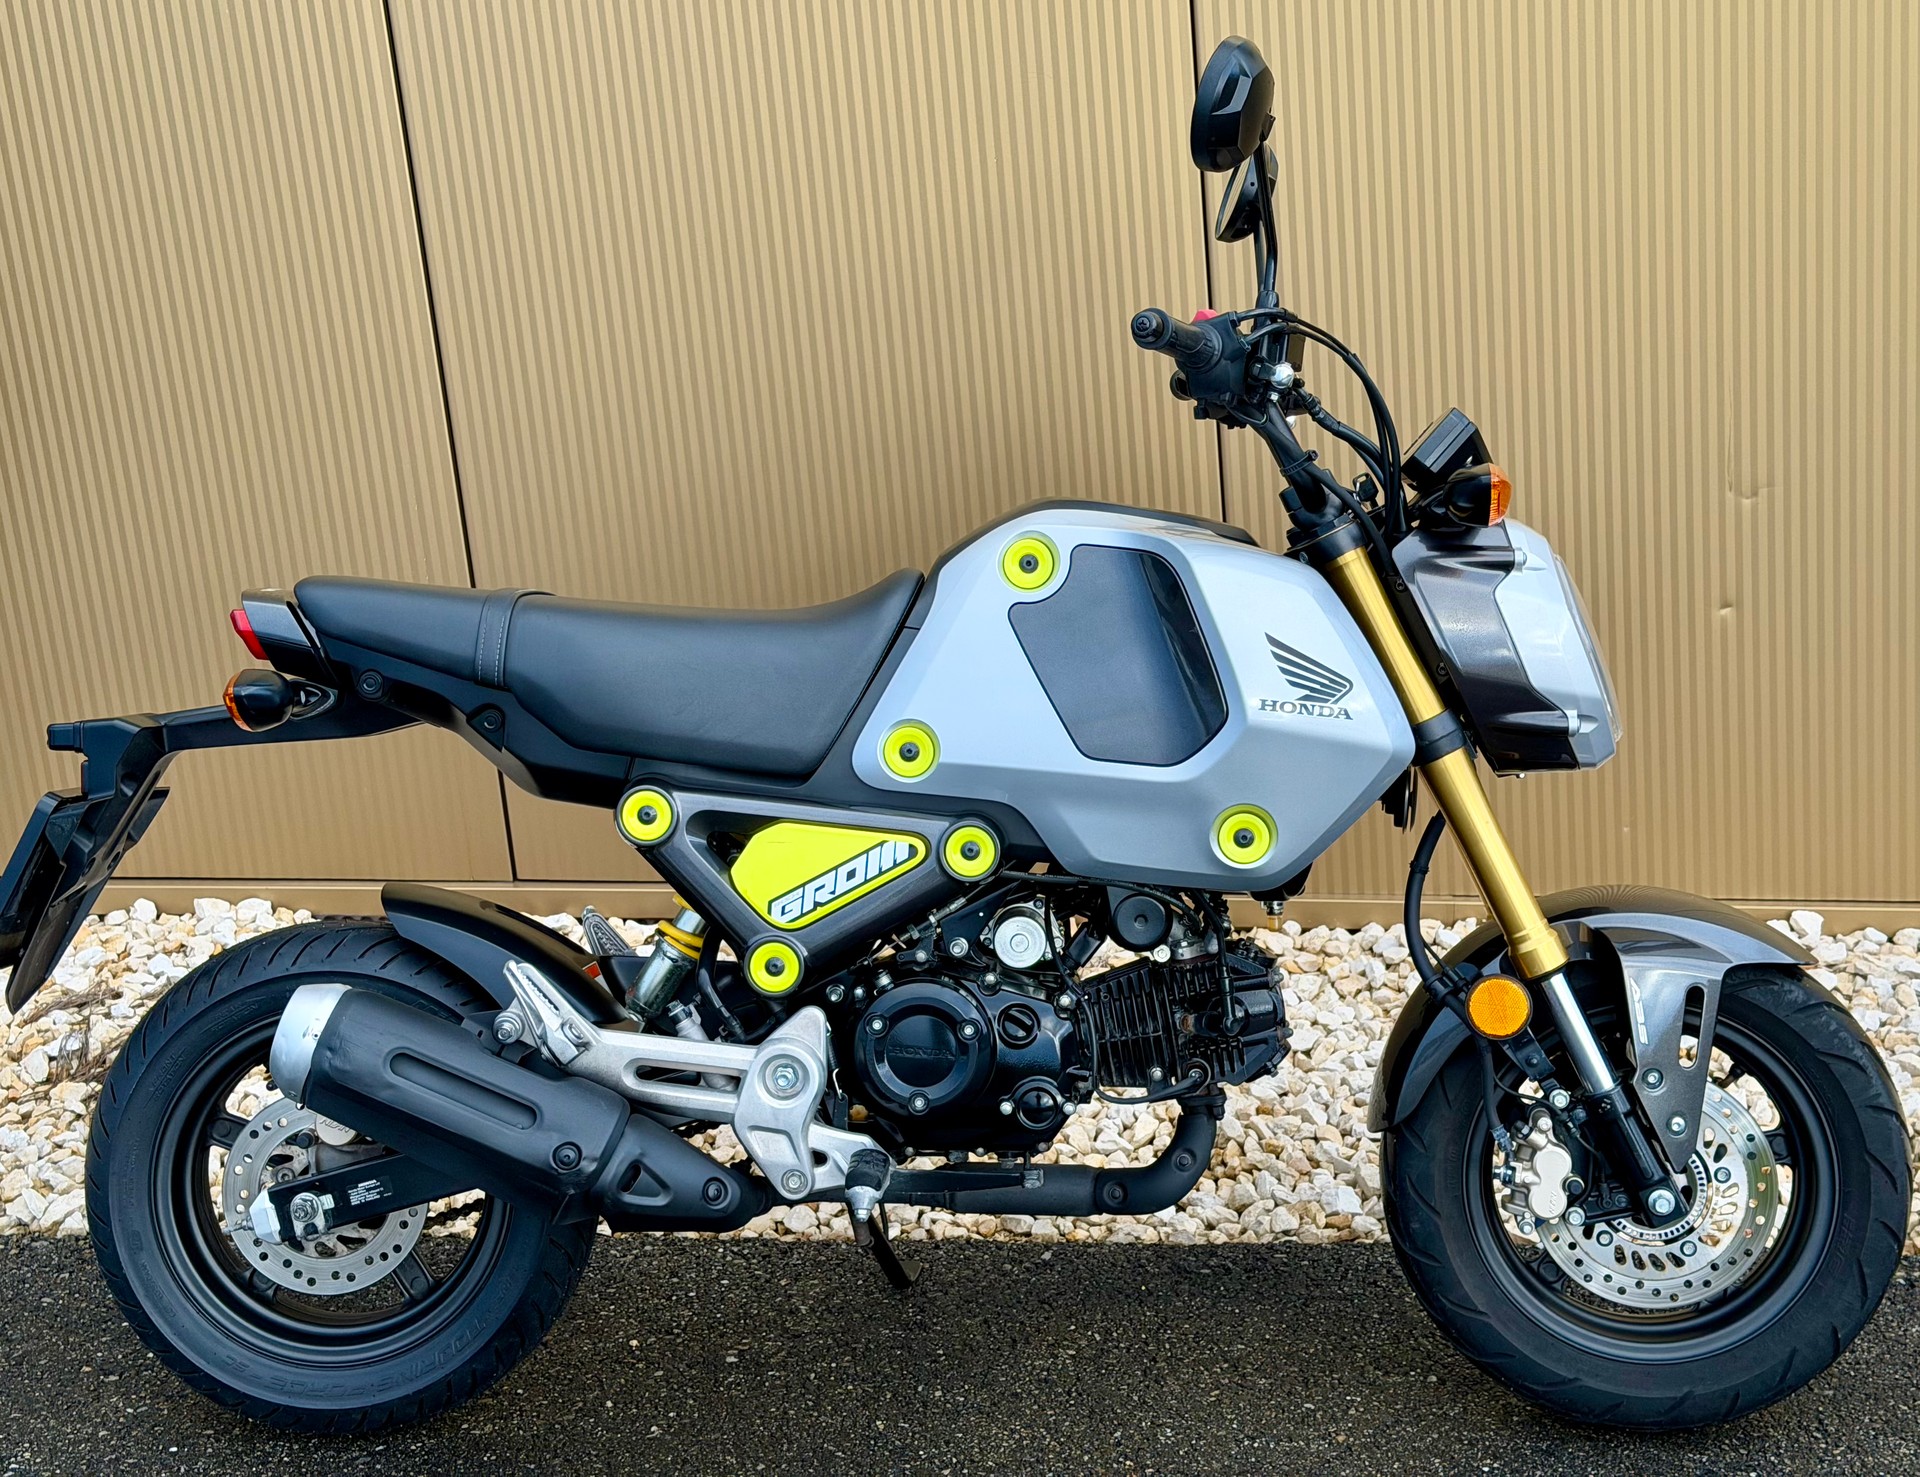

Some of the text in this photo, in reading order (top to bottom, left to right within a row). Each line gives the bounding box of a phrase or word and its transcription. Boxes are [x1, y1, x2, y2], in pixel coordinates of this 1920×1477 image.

[1258, 699, 1354, 720] HONDA
[771, 839, 910, 923] GROM
[1629, 976, 1649, 1045] ABS
[888, 1045, 956, 1060] HONDA
